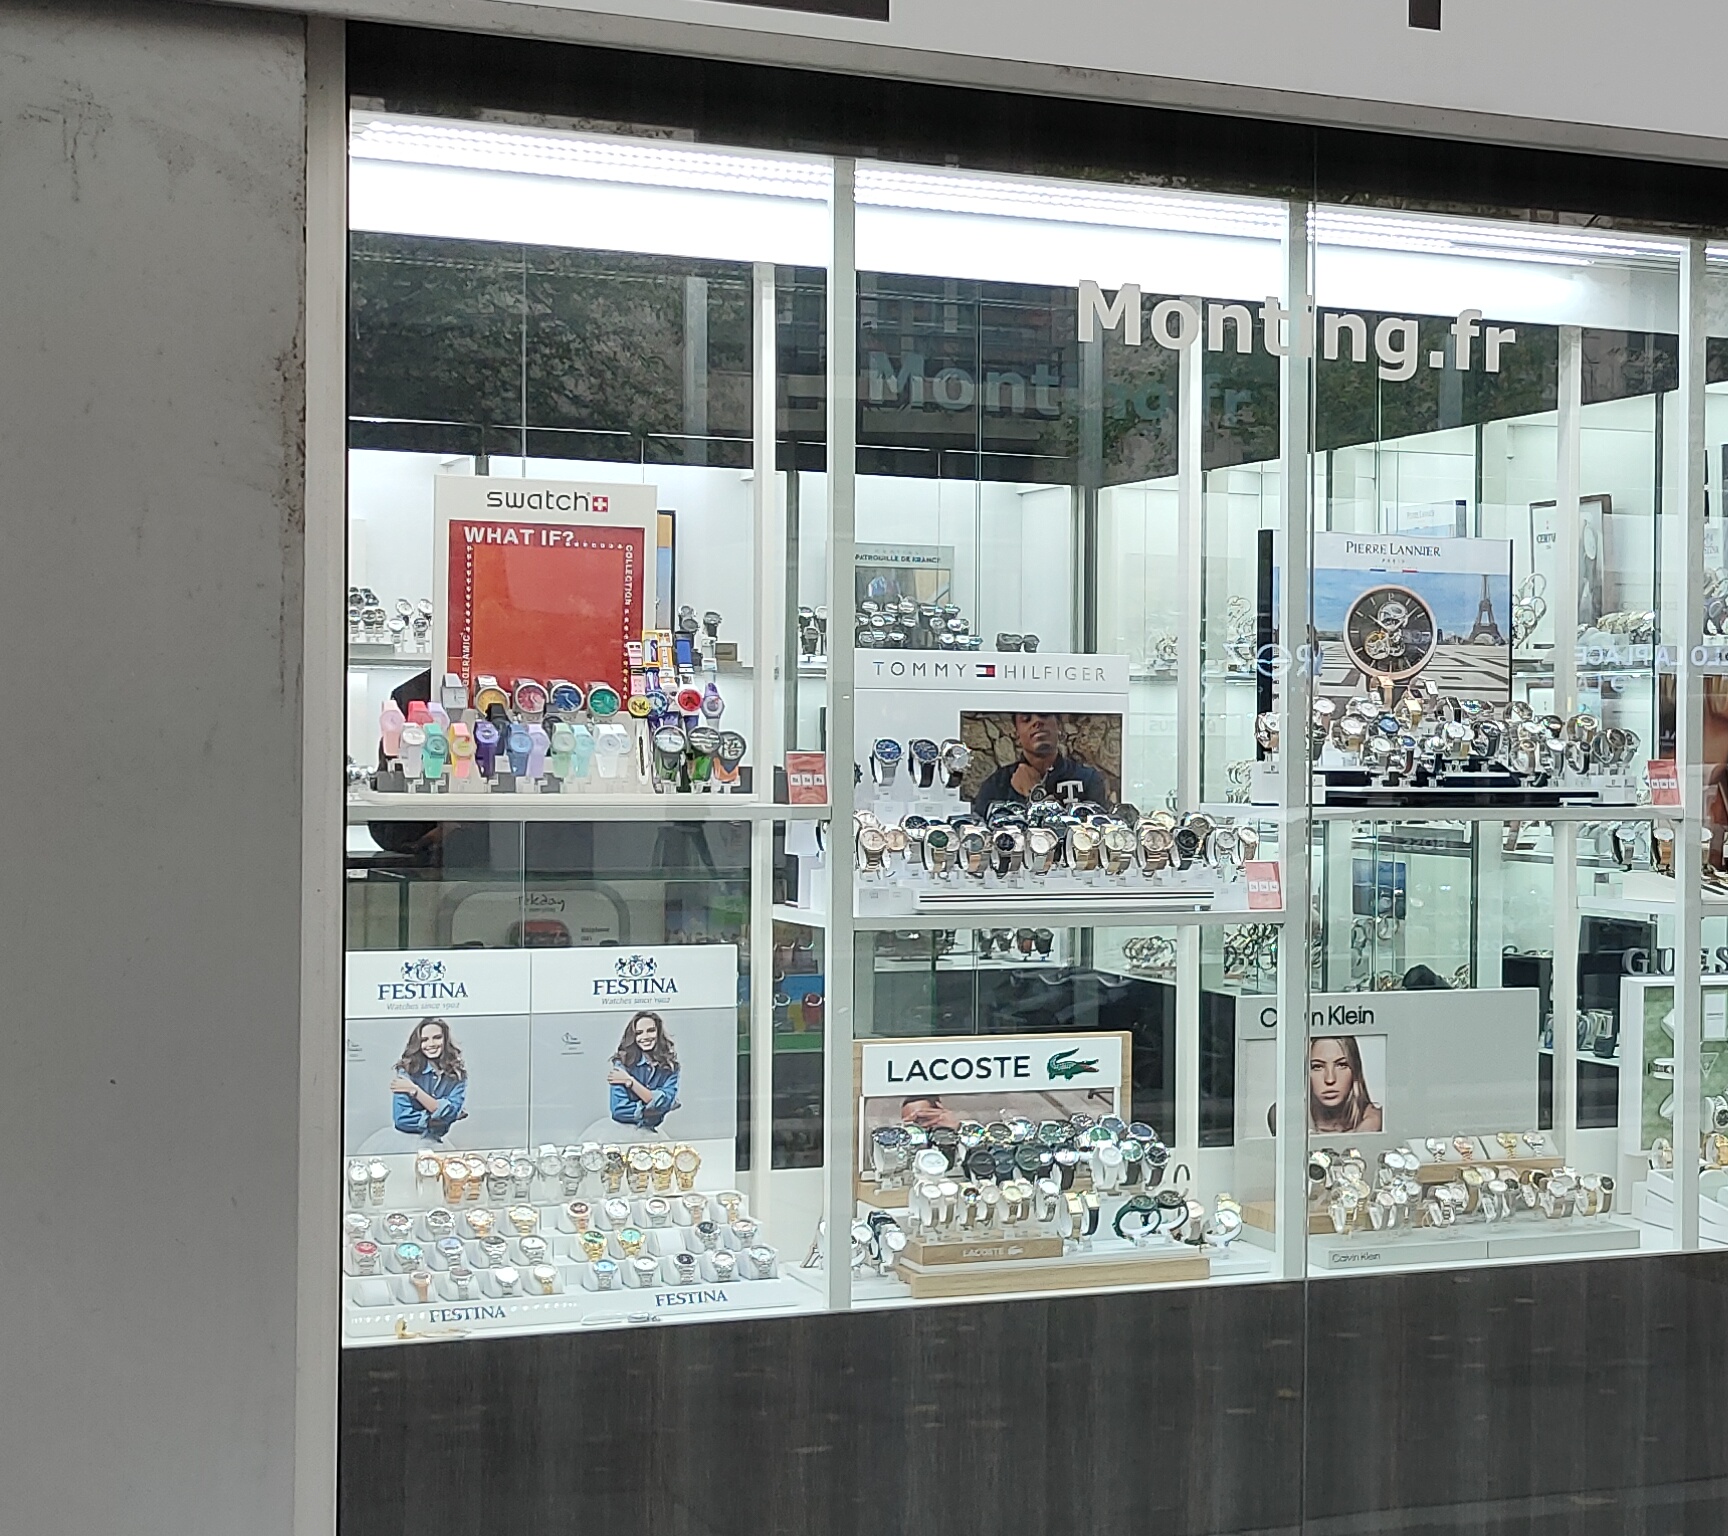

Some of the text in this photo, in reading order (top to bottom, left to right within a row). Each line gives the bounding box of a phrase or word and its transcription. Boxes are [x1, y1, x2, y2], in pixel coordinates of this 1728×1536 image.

[1077, 279, 1516, 382] Monting.fr
[486, 490, 590, 512] swatch
[463, 526, 575, 547] WHAT IF?
[1346, 541, 1441, 557] PIERRE LANNIER
[624, 544, 634, 606] COLLECTION
[873, 661, 1106, 682] TOMMY HILFIGER
[378, 982, 469, 1001] FESTINA
[593, 977, 679, 995] FESTINA
[1328, 1005, 1374, 1026] Klein
[887, 1055, 1031, 1083] LACOSTE
[654, 1289, 729, 1308] FESTINA
[428, 1304, 507, 1324] FESTINA
